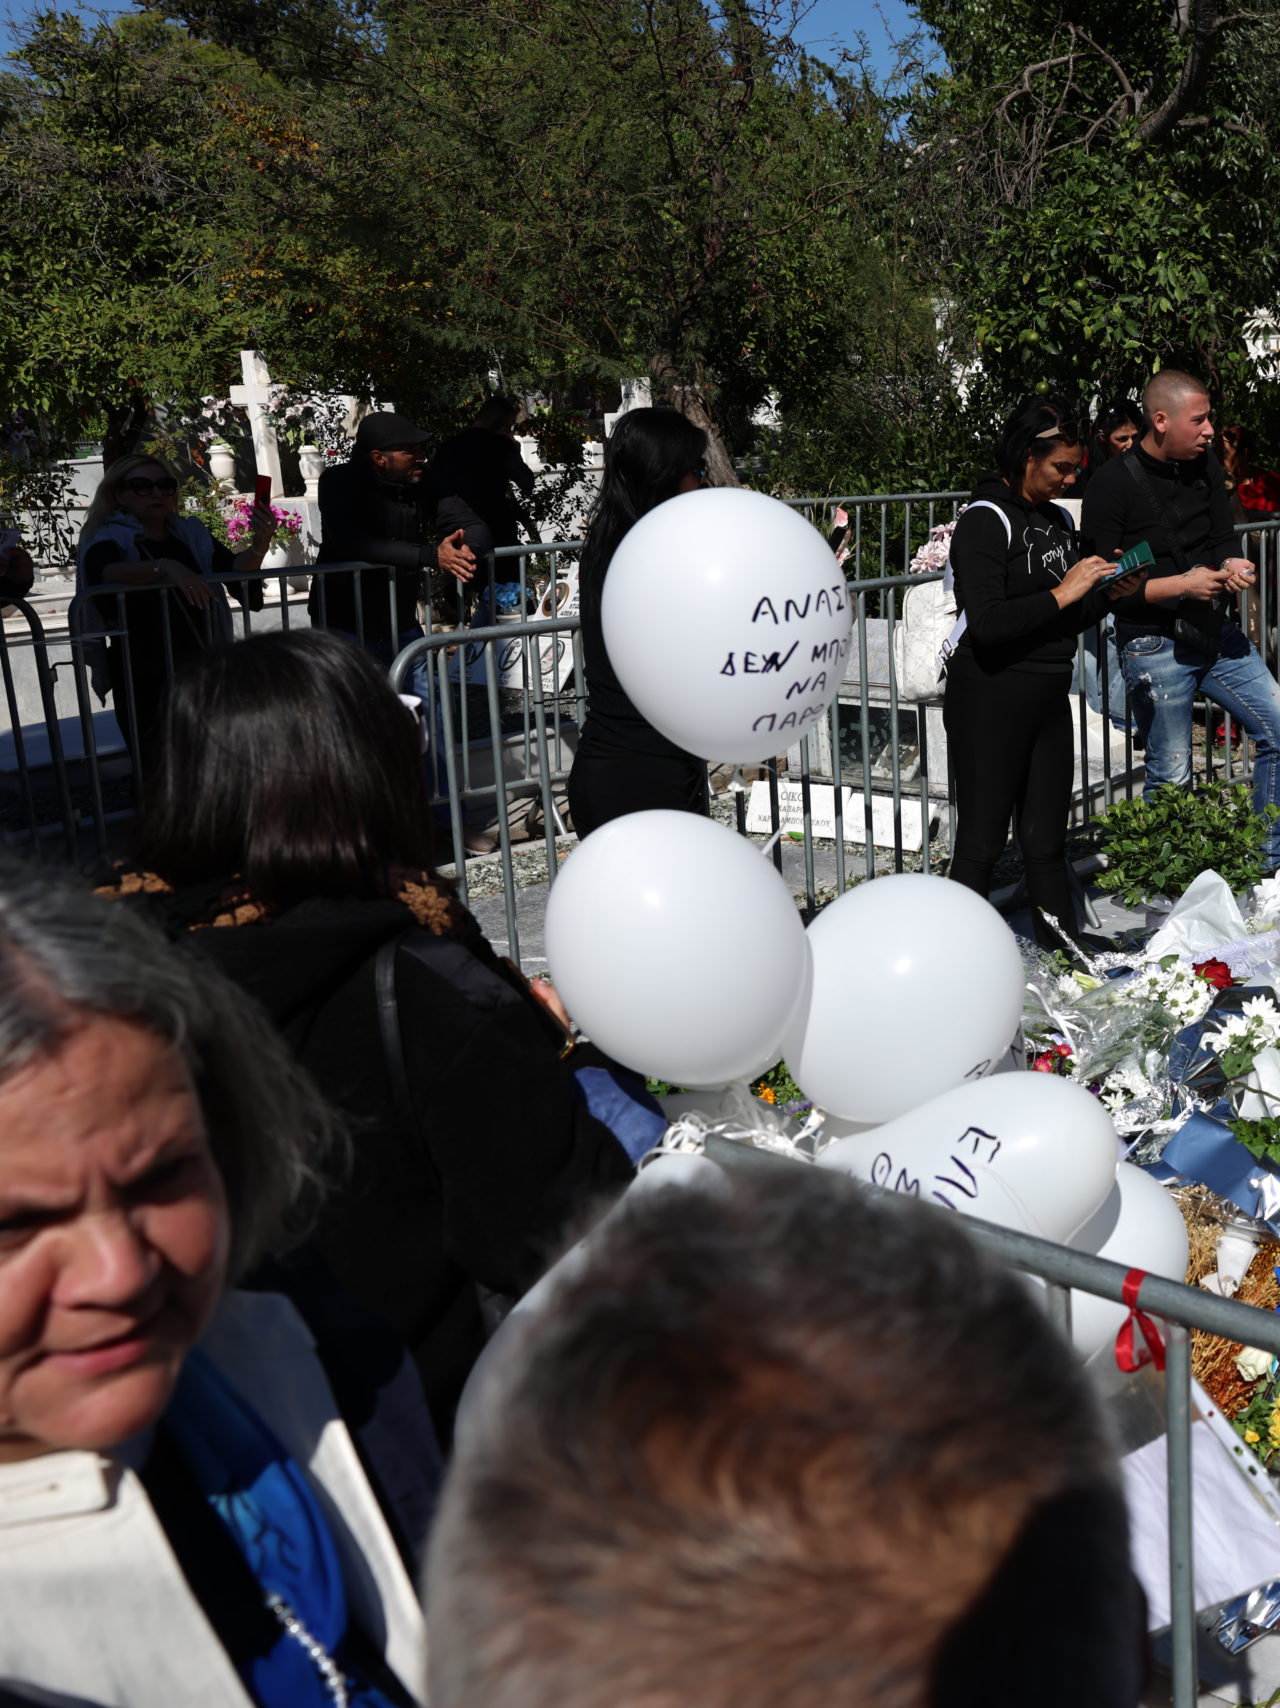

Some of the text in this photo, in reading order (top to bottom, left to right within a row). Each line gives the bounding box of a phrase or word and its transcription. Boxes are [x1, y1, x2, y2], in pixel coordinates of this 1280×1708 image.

[751, 583, 849, 625] ΑΝΑΣ
[811, 634, 851, 666] ΜΠΟ
[785, 671, 827, 700] ΝΑ
[780, 791, 804, 802] ΟΙΚΟ
